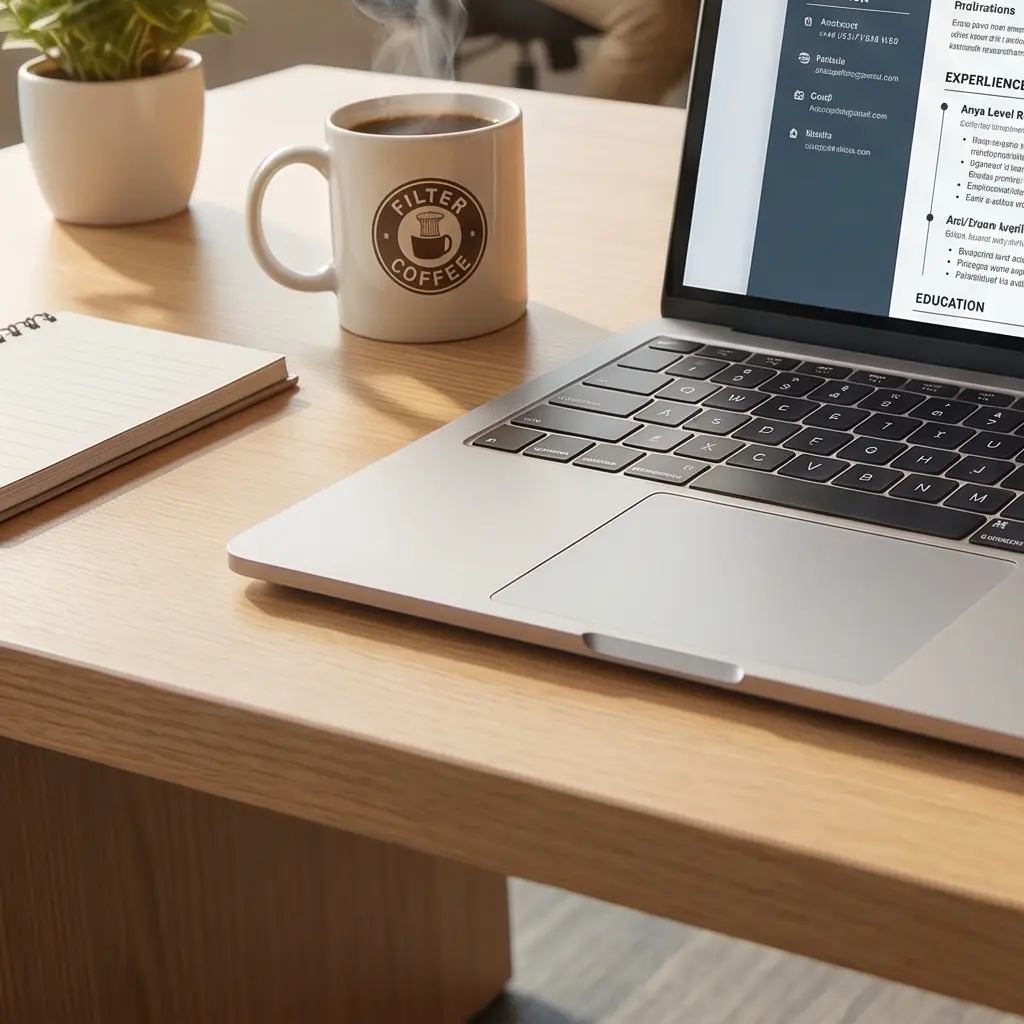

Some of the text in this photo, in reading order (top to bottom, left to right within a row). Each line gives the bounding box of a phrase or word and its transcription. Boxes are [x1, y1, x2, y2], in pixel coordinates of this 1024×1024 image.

[961, 105, 985, 119] Anya
[988, 108, 1014, 118] Level
[391, 188, 468, 216] FILTER
[391, 254, 472, 286] COFFEE
[916, 292, 985, 313] EDUCATION
[727, 394, 745, 402] W
[987, 440, 1001, 448] U
[758, 426, 774, 434] D
[916, 455, 933, 463] H
[701, 443, 987, 503] X C V B N M
